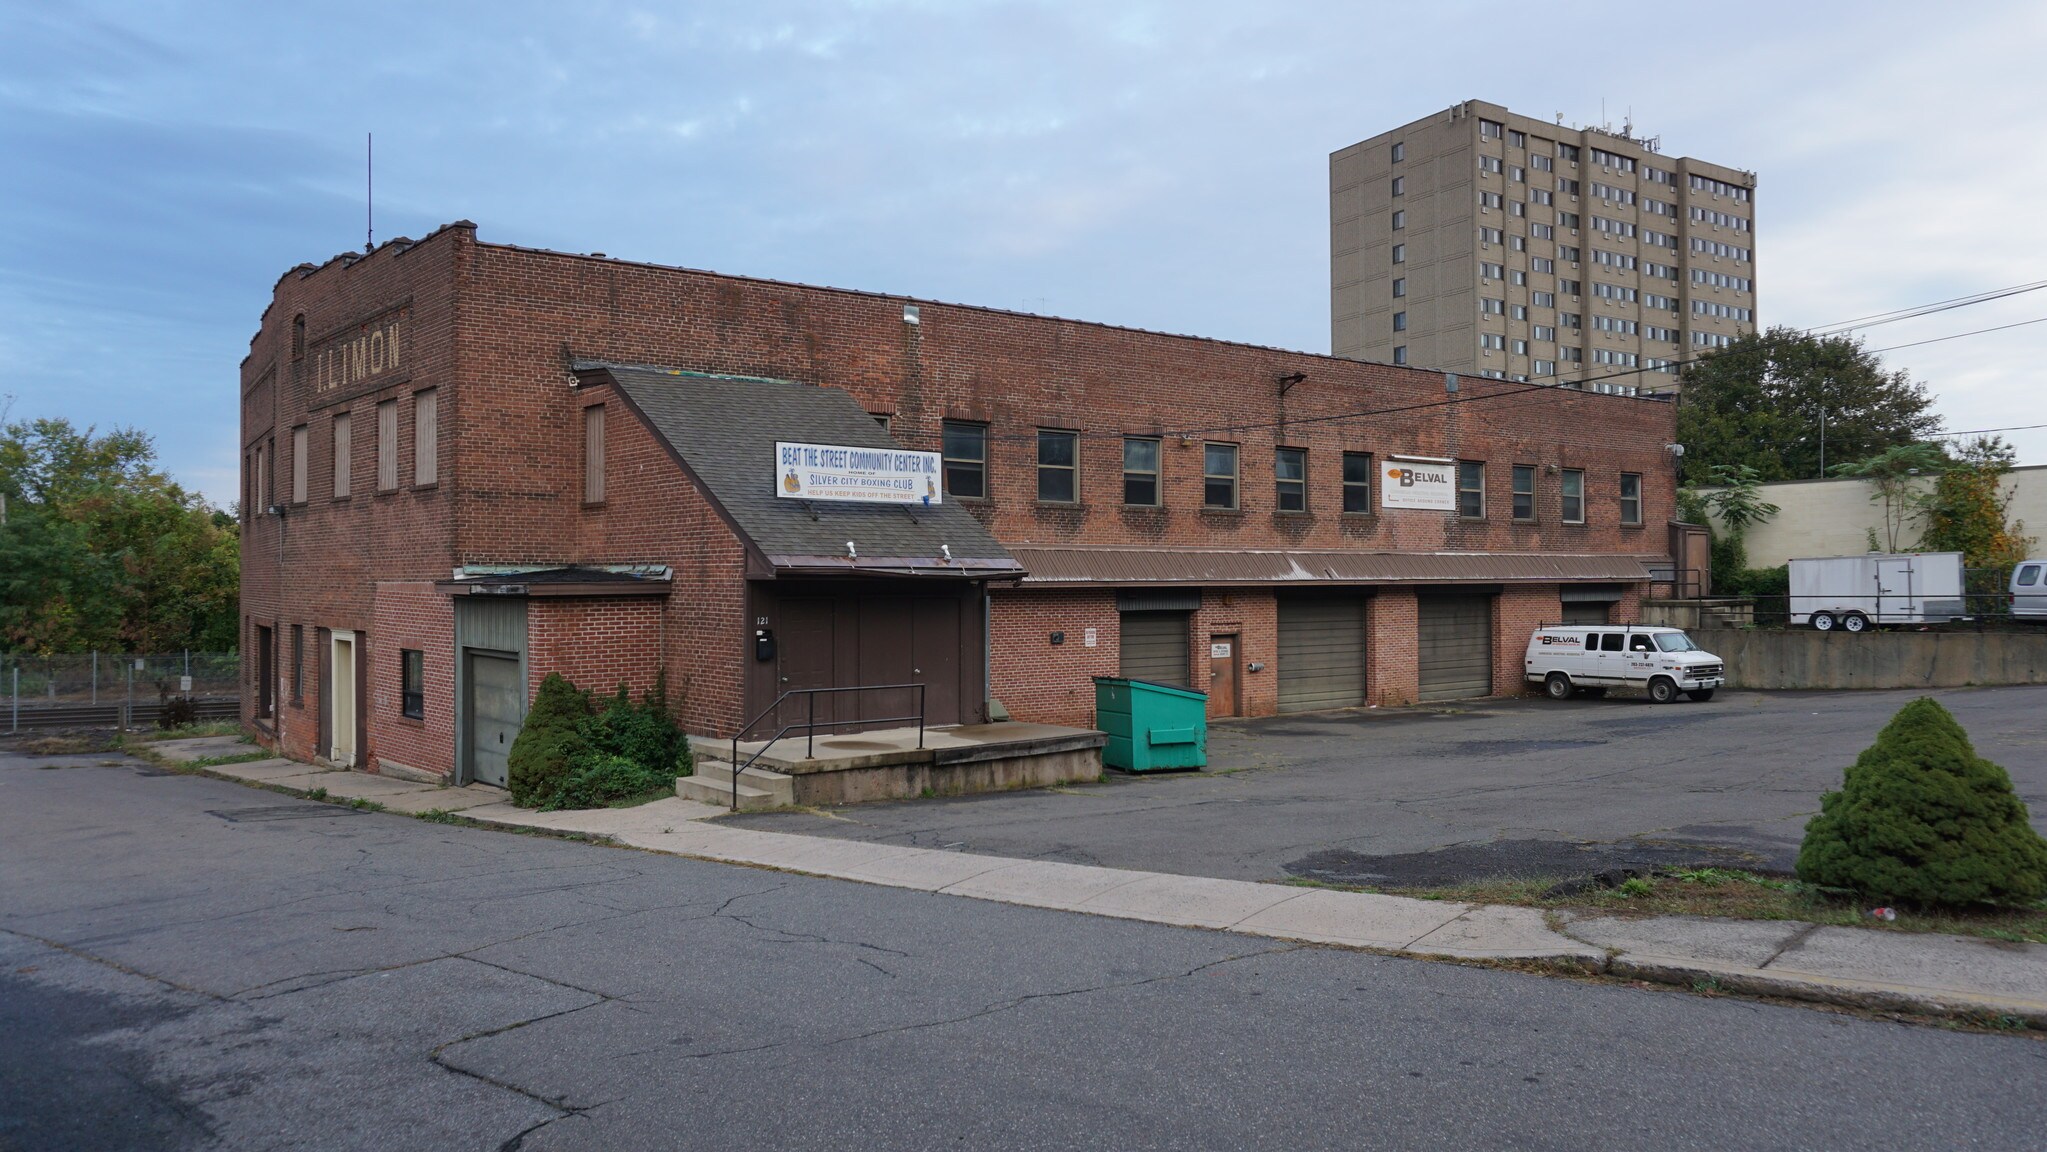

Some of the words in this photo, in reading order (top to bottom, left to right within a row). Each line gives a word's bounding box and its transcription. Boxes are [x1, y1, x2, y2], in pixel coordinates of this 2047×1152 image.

[782, 447, 801, 466] BEAT
[804, 447, 818, 467] THE
[820, 449, 848, 469] STREET
[849, 451, 893, 471] COMMUNITY
[894, 454, 920, 473] CENTER
[922, 456, 937, 474] INC.
[809, 473, 838, 486] SILVER
[840, 477, 858, 486] CITY
[861, 478, 891, 488] BOXING
[893, 479, 913, 490] CLUB
[1400, 468, 1447, 487] BELVAL
[757, 616, 768, 625] 121
[1542, 635, 1581, 645] BELVAL
